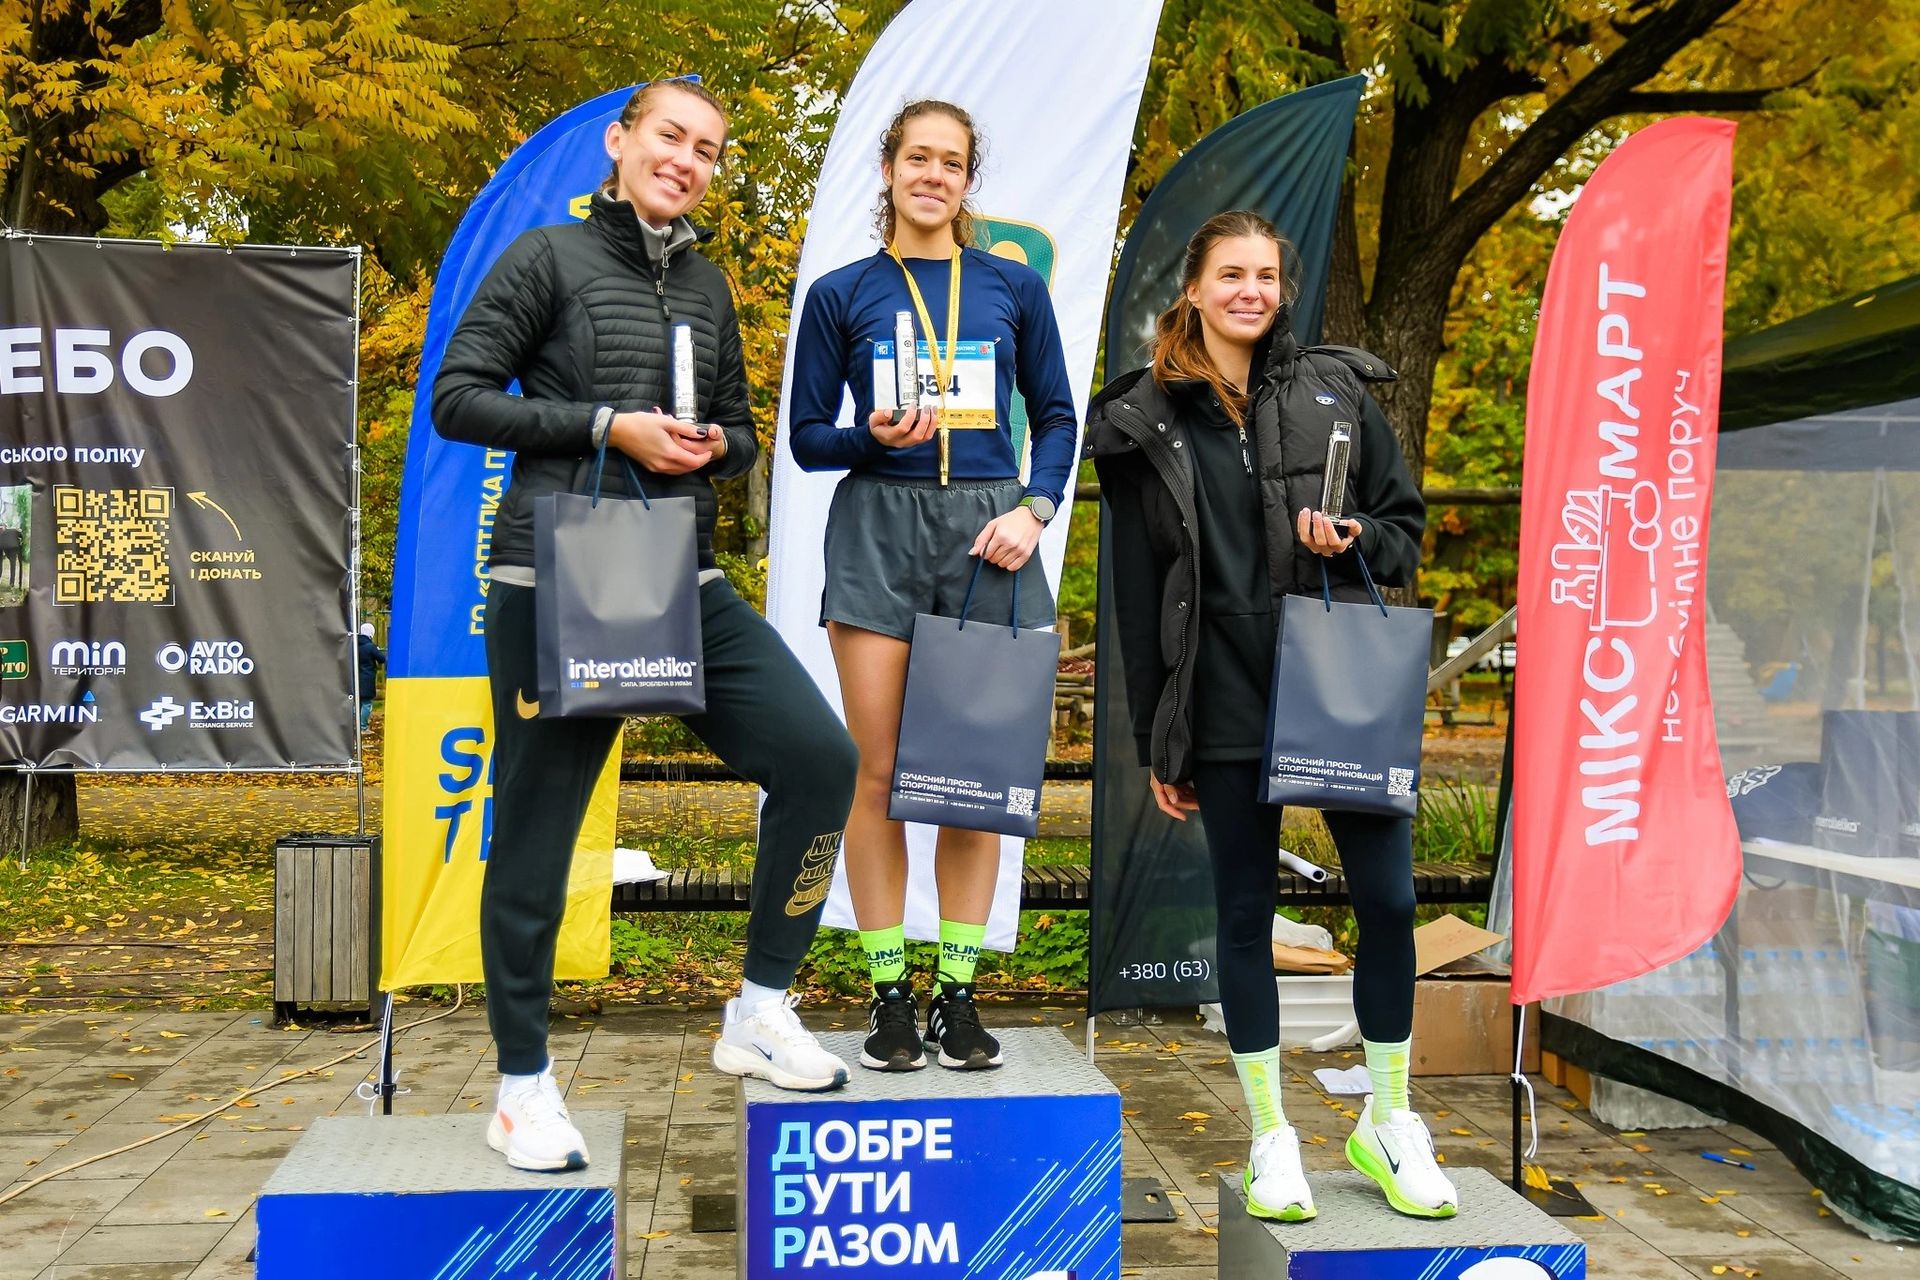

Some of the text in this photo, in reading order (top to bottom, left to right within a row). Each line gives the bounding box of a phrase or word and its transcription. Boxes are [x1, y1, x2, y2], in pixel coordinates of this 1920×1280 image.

[1667, 369, 1702, 501] поруч
[74, 447, 145, 468] полку
[485, 447, 507, 469] П
[190, 549, 255, 563] СКАНУЙ
[1580, 262, 1646, 846] МІКС МАРТ
[198, 568, 262, 581] ДОНАТЬ
[51, 641, 126, 666] min
[190, 641, 244, 658] AVTO
[52, 667, 126, 675] ТЕРИТОРІЯ
[190, 658, 254, 675] RADIO
[569, 656, 693, 679] interatletika
[0, 705, 98, 723] GARMIN
[190, 700, 254, 719] ExBid
[1278, 756, 1362, 770] СУЧАСНИЙ ПРОСТІР
[1278, 764, 1335, 776] СПОРТИВНИХ
[1336, 772, 1383, 781] ІННОВАЦІЙ
[900, 780, 956, 794] СПОРТИВНИХ
[956, 789, 1002, 800] ІННОВАЦІЙ
[901, 772, 982, 789] СУЧАСНИЙ ПРОСТІР
[809, 830, 843, 856] NIK
[943, 941, 980, 955] RUN
[1119, 958, 1210, 982] +380 (63)
[771, 1117, 953, 1171] ДОБРЕ
[774, 1170, 911, 1216] БУТИ
[774, 1222, 960, 1268] РАЗОМ
